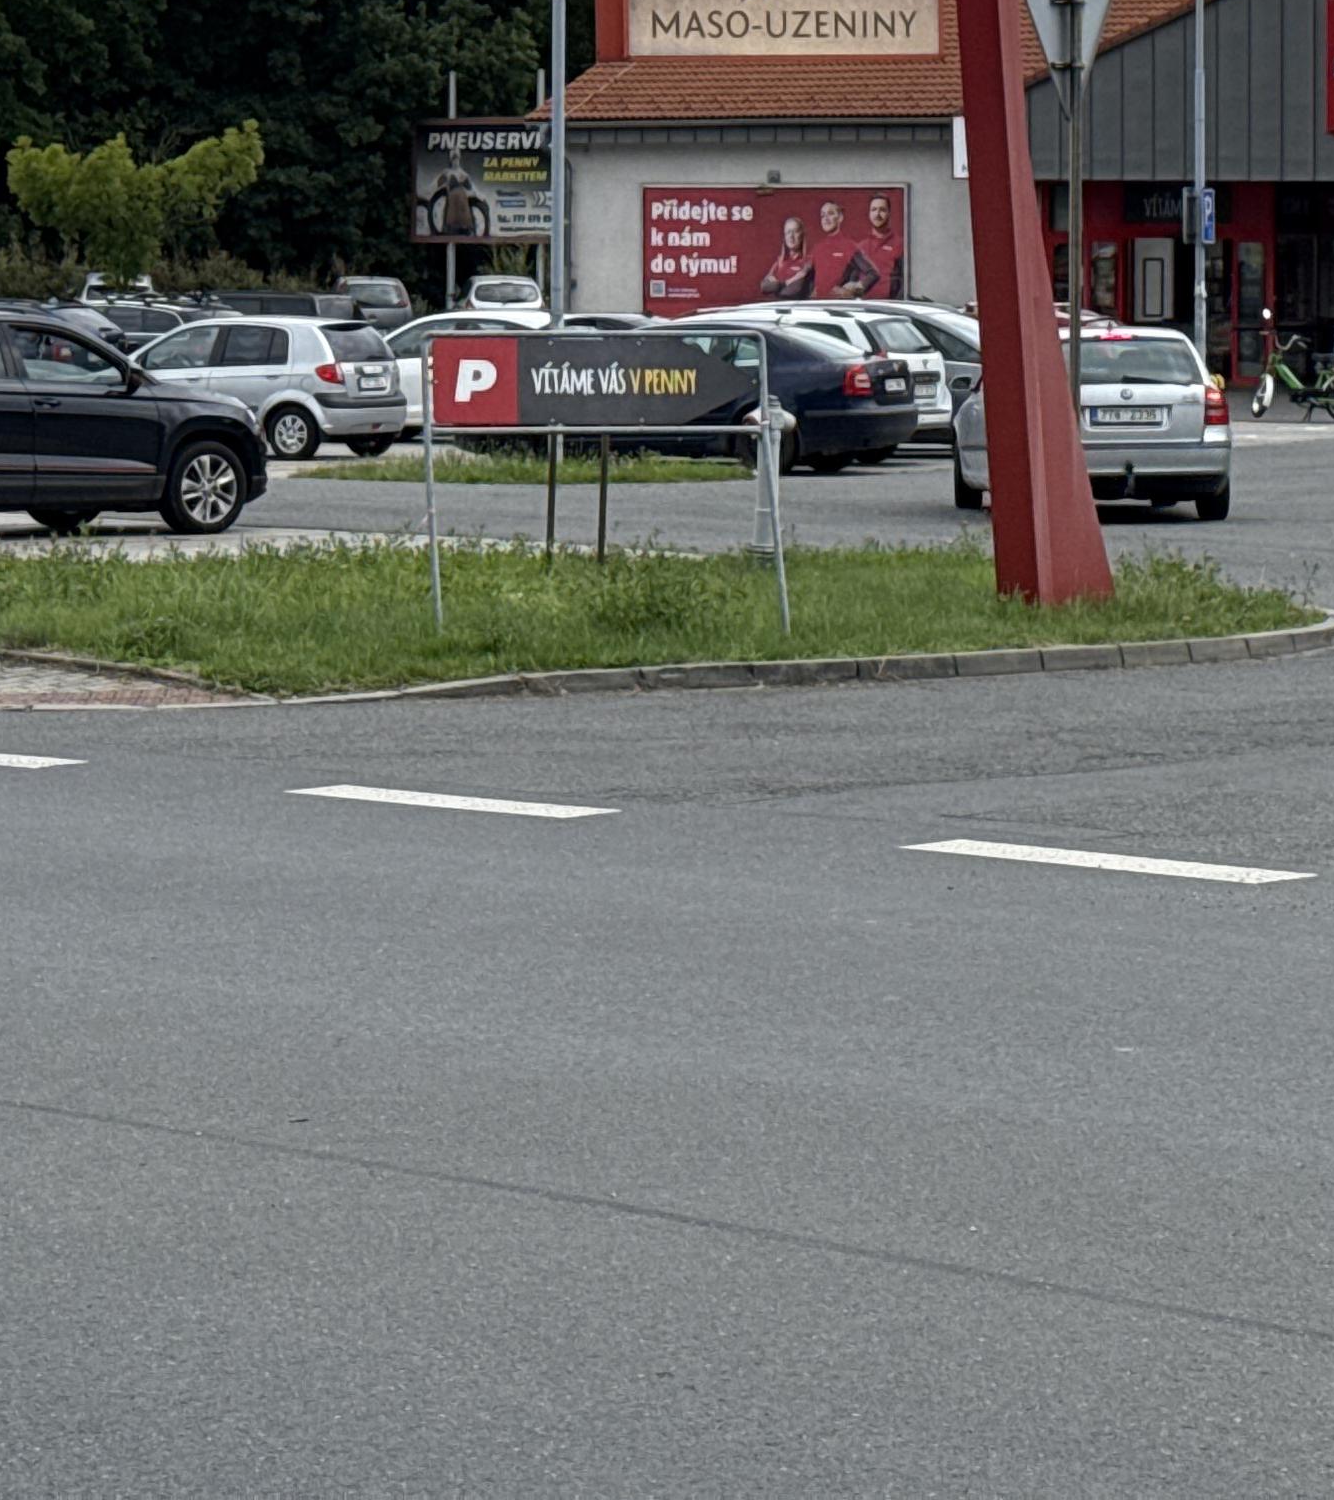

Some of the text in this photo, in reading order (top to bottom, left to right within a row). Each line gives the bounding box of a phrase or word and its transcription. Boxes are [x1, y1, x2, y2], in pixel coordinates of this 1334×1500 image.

[651, 9, 917, 38] MASO-UZENINY
[427, 131, 542, 150] PNEUSERVI
[483, 156, 540, 168] ZA PENNY
[651, 198, 754, 225] Přidejte se
[1143, 193, 1182, 218] VÍTÁM
[651, 225, 710, 246] k nám
[650, 252, 738, 277] do týmu!
[454, 359, 497, 403] P
[531, 361, 697, 396] VÍTÁME VÁS V PENNY
